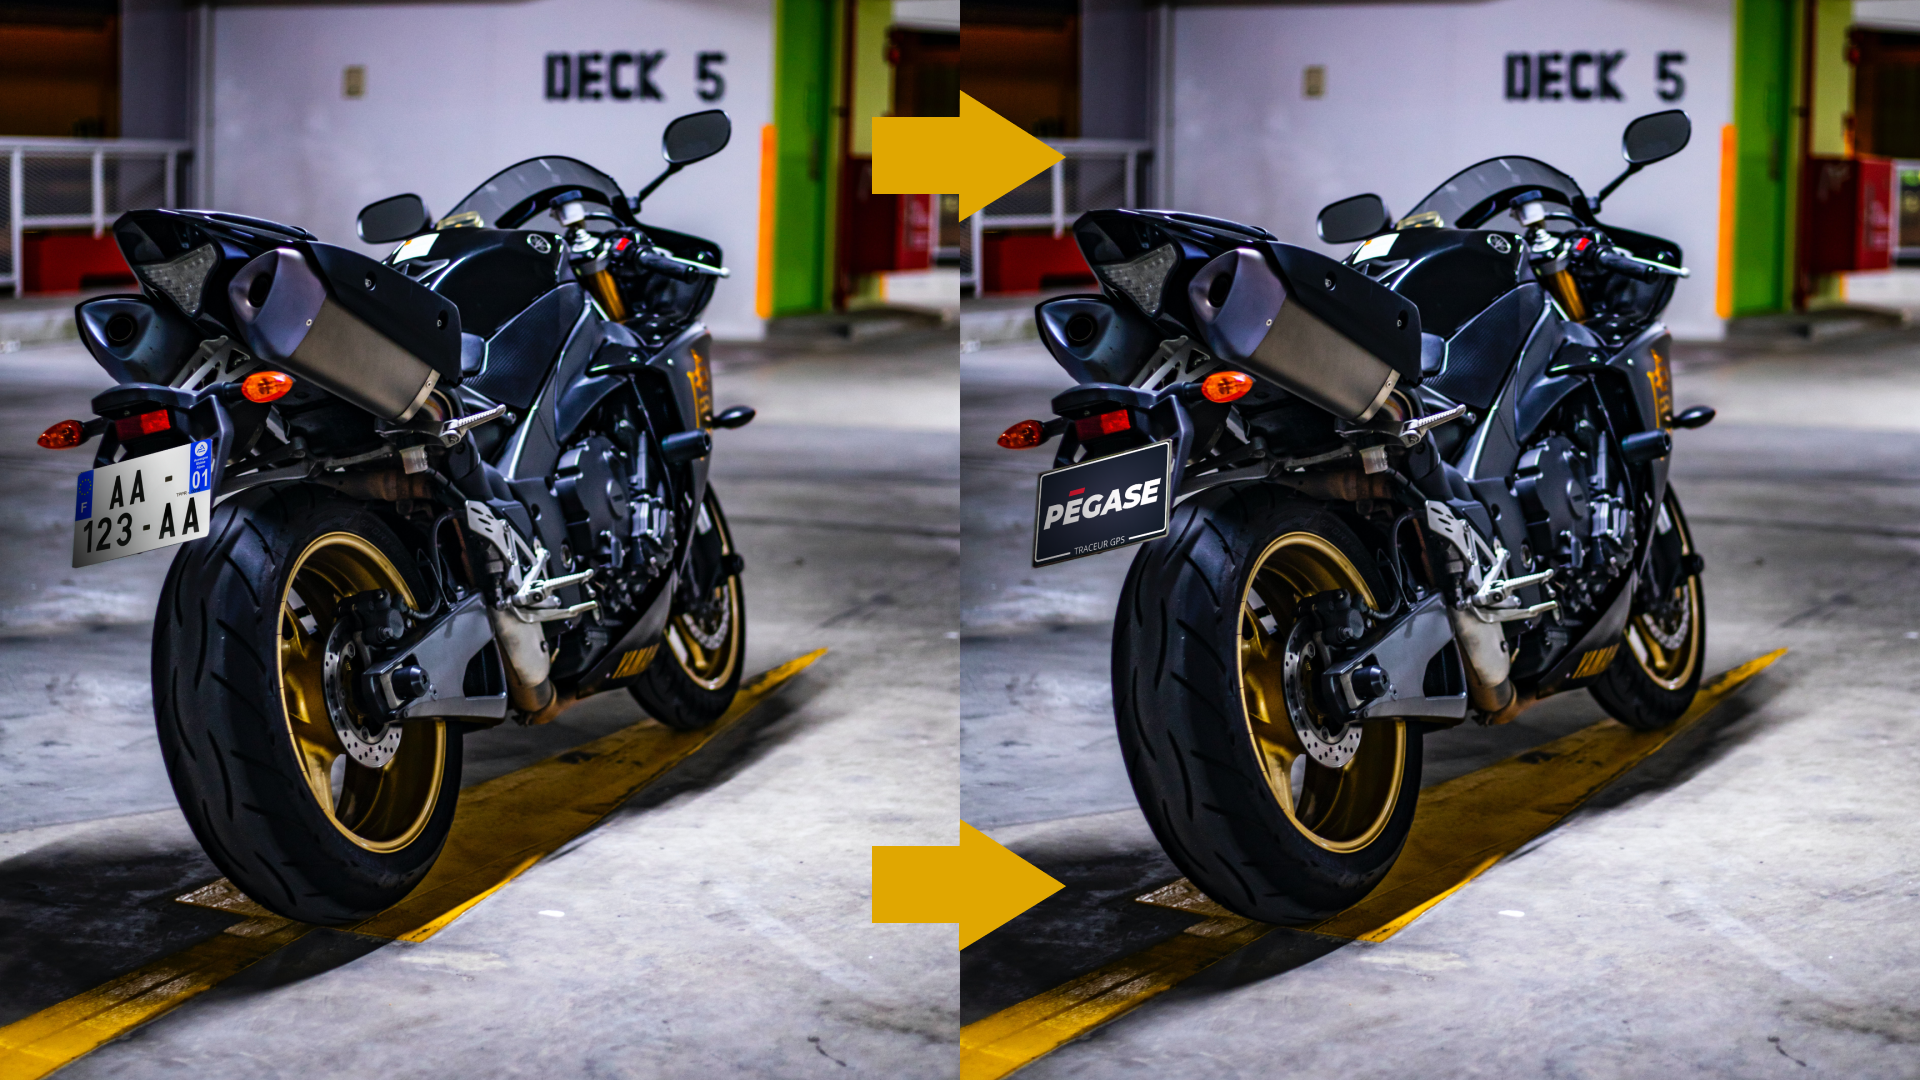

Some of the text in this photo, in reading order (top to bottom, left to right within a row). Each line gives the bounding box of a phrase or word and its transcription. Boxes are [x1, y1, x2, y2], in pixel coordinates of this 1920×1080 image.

[545, 51, 728, 104] DECK 5
[1505, 51, 1688, 104] DECK 5
[192, 468, 208, 489] 01
[80, 501, 88, 514] F
[1074, 535, 1126, 556] TRACEUR GPS
